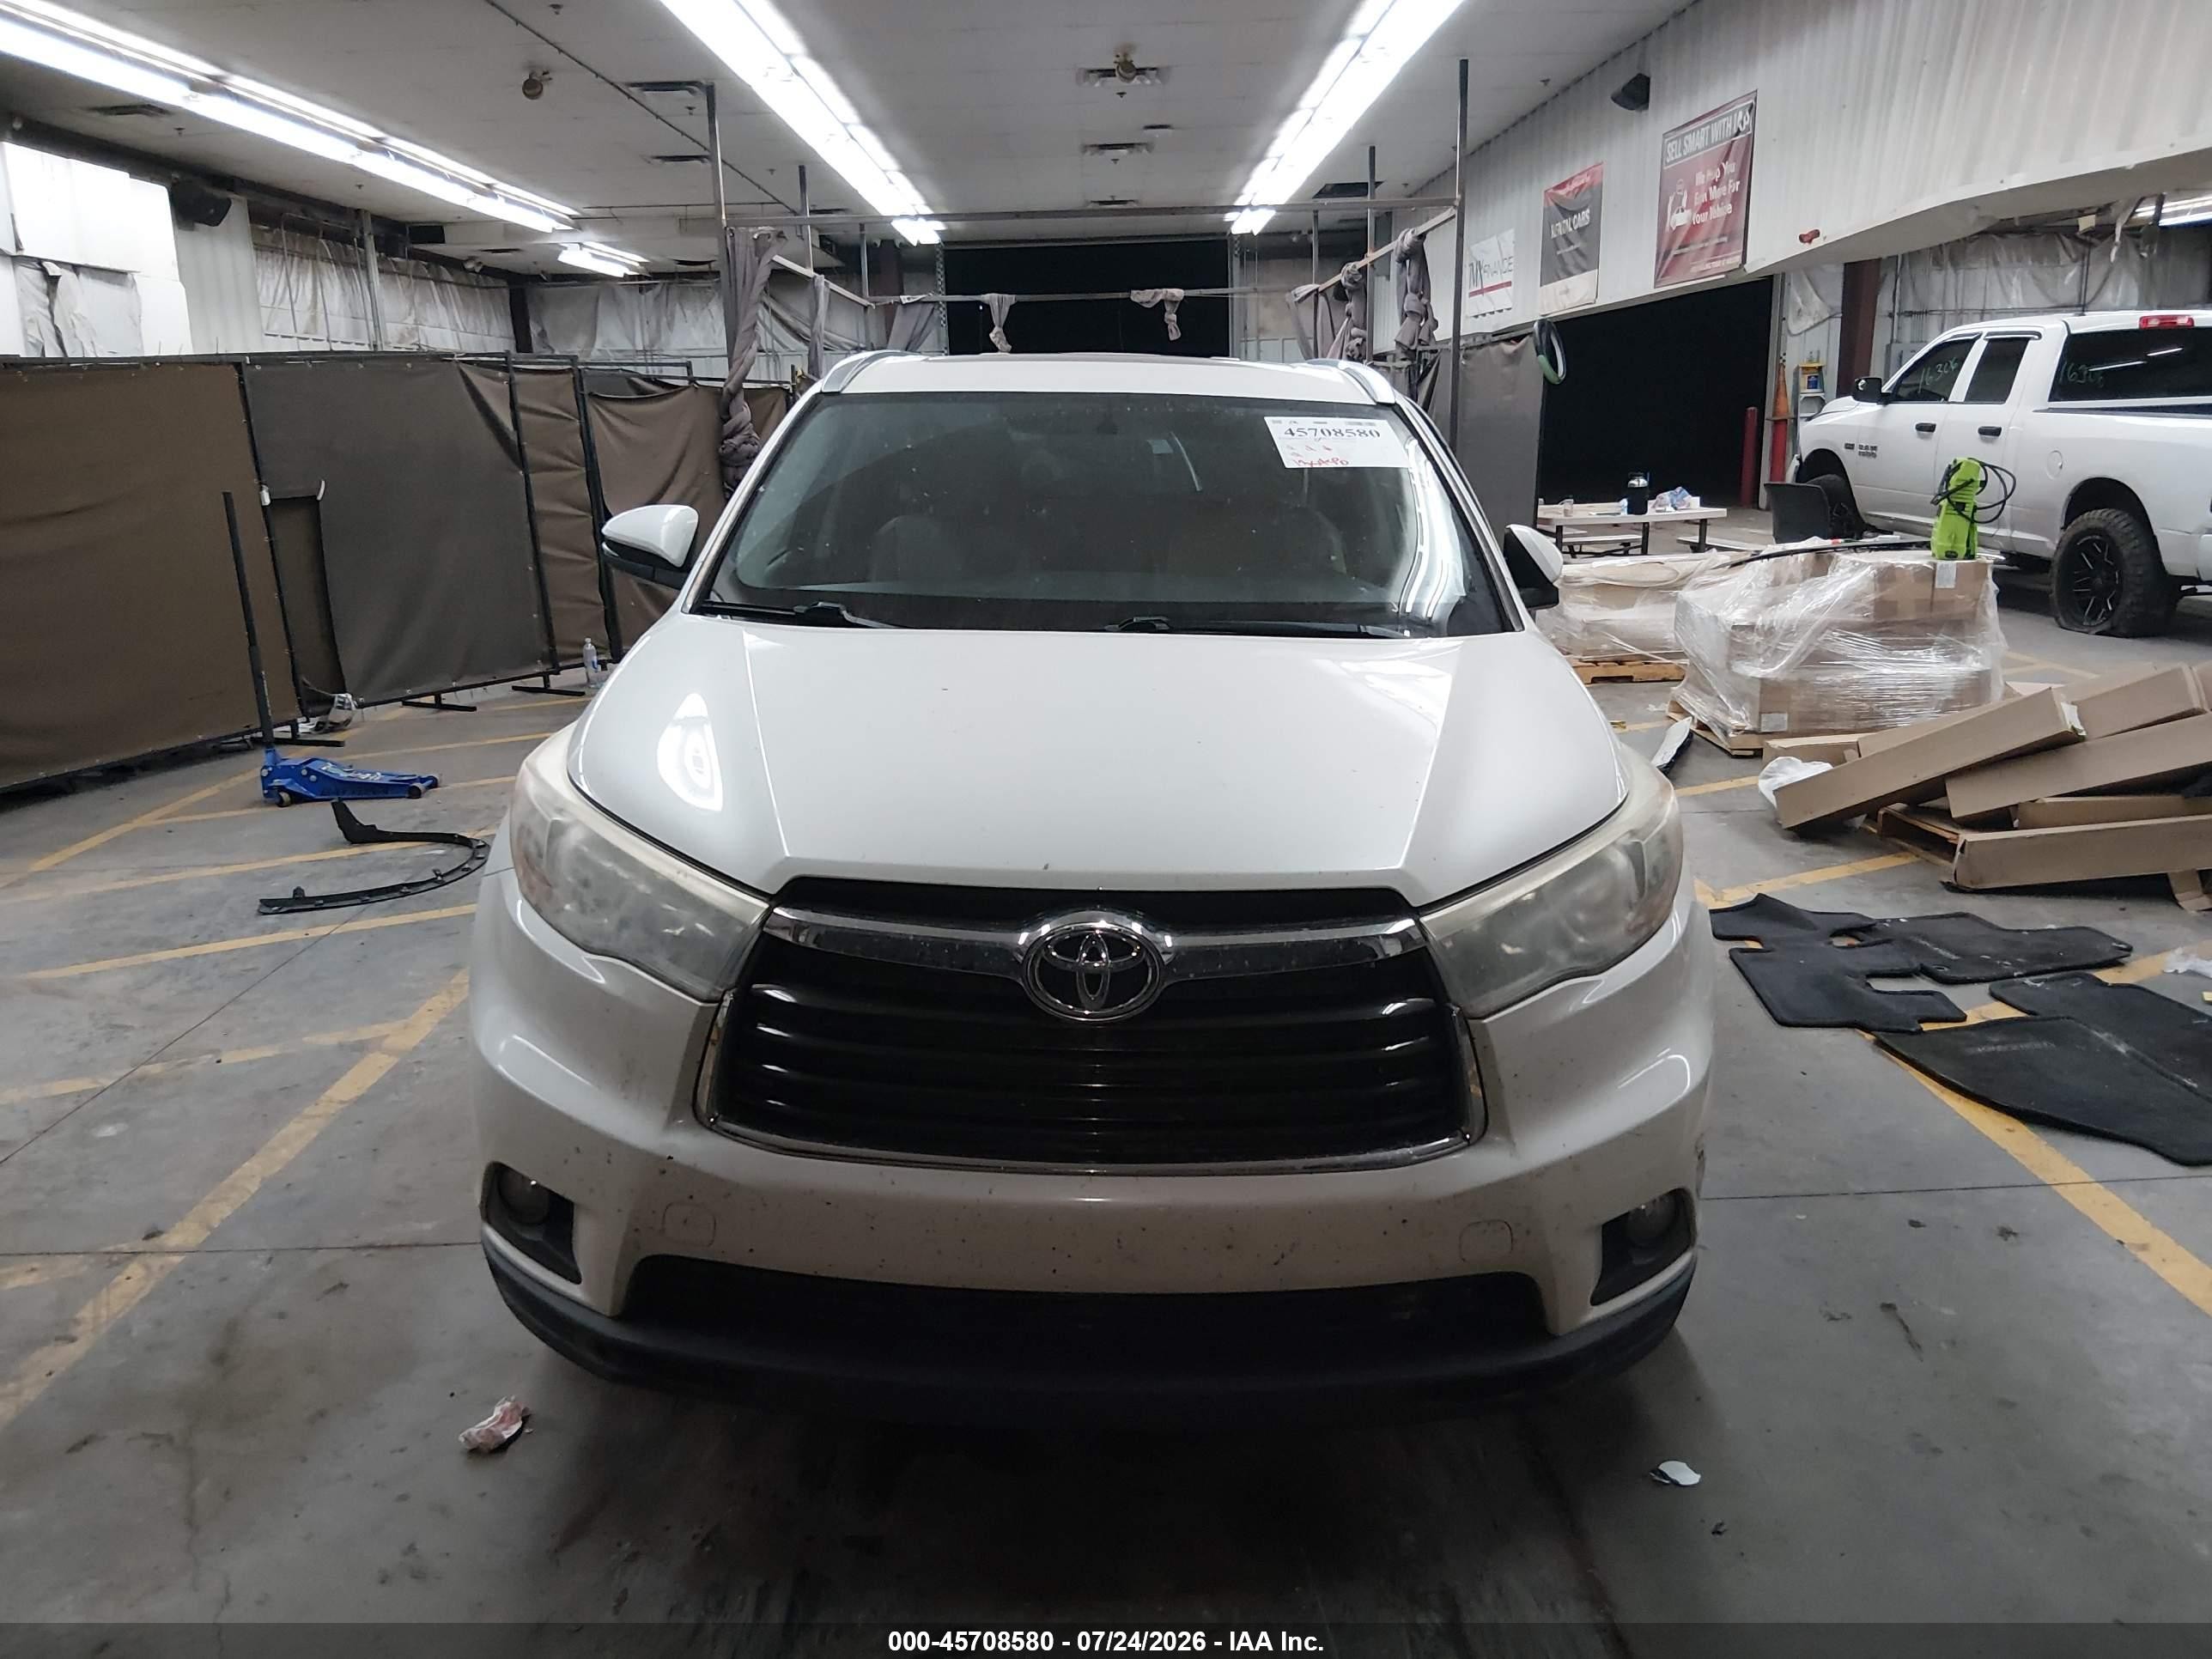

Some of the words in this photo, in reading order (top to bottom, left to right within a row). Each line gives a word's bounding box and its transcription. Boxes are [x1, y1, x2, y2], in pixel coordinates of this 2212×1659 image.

[1667, 139, 1682, 162] SELL
[1683, 125, 1711, 155] SMART
[1711, 115, 1733, 143] WITH
[1284, 428, 1381, 439] 45708580
